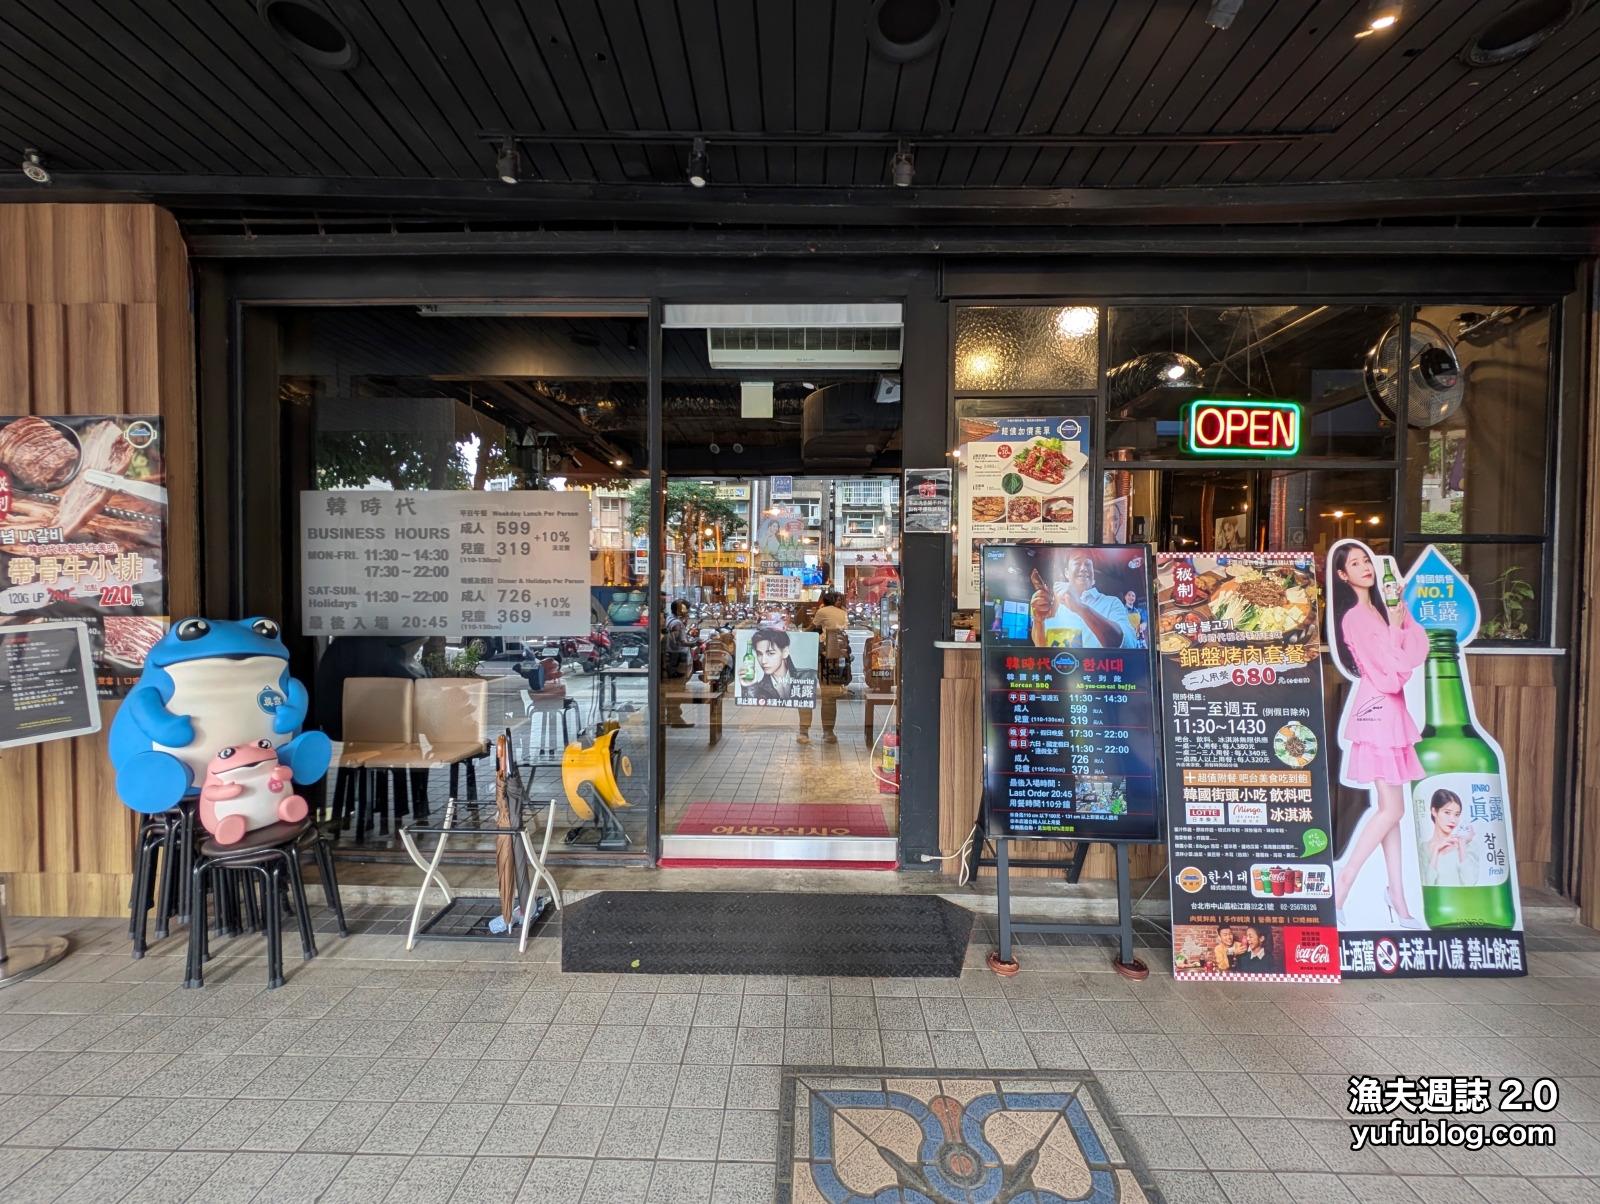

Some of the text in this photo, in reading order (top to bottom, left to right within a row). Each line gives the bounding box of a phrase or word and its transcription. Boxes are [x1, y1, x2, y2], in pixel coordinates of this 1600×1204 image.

[1197, 408, 1295, 446] OPEN
[326, 498, 416, 516] 韓時代
[308, 527, 450, 540] BUSINESS HOURS
[460, 521, 530, 535] 成人 599
[20, 528, 64, 543] LA갈비
[534, 531, 570, 542] +10%
[461, 542, 530, 555] 兒童 319
[308, 551, 359, 560] MON-FRI.
[8, 553, 143, 585] 帶骨牛小排
[1416, 575, 1454, 584] 韓國銷售
[308, 587, 359, 595] SAT-SUN.
[461, 589, 531, 602] 成人 726
[1417, 585, 1454, 598] NO.1
[8, 593, 29, 604] 120G
[33, 593, 44, 602] UP
[309, 599, 357, 609] Holidays
[535, 597, 570, 608] +10%
[309, 616, 447, 629] 最後入場 20:45
[462, 610, 531, 623] 兒童 369
[1175, 619, 1234, 634] 옛날 불고기
[1180, 644, 1305, 667] 銅盤烤肉套餐
[1006, 657, 1123, 672] 韓時代 한시대
[1190, 671, 1229, 685] 二人用餐
[1232, 667, 1276, 686] 680
[793, 700, 813, 708] 禁止飲酒
[1069, 694, 1092, 702] 11:30
[1070, 705, 1087, 713] 599
[1173, 702, 1309, 717] 週一至週五 (例假日除外)
[1015, 715, 1029, 723] 兒童
[1071, 716, 1088, 724] 319
[1174, 719, 1266, 734] 11:30~1430
[1070, 730, 1093, 738] 17:30
[1105, 746, 1129, 754] 22:00
[1071, 755, 1089, 764] 726
[1072, 766, 1089, 774] 379
[1198, 773, 1308, 783] 超值附餐 吧台美食吃到飽
[1472, 784, 1490, 793] JINRO
[1183, 788, 1312, 803] 韓國街頭小吃 飲料吧
[1010, 799, 1070, 808] 用餐時間110分鐘
[1271, 808, 1313, 822] 冰淇淋
[1208, 870, 1247, 884] 한시대
[1489, 867, 1503, 875] fresh
[1399, 938, 1465, 971] 未滿十八歲
[1468, 938, 1522, 971] 禁止飲酒
